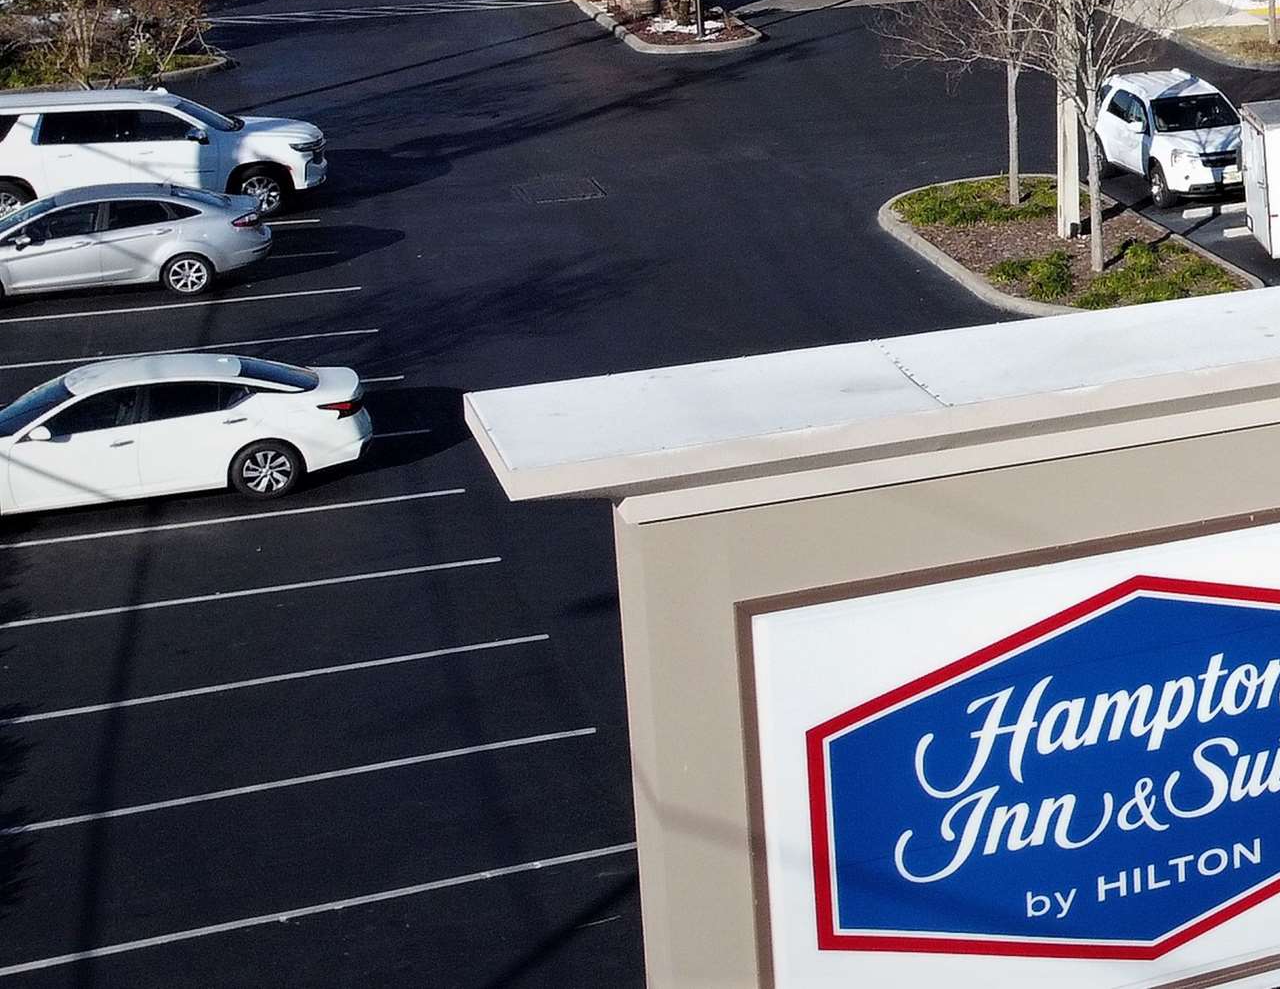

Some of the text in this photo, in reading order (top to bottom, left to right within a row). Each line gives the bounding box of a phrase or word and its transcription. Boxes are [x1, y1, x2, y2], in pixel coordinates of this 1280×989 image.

[894, 786, 1113, 883] Inn
[1118, 777, 1169, 831] &
[1026, 838, 1261, 918] by HILTON
